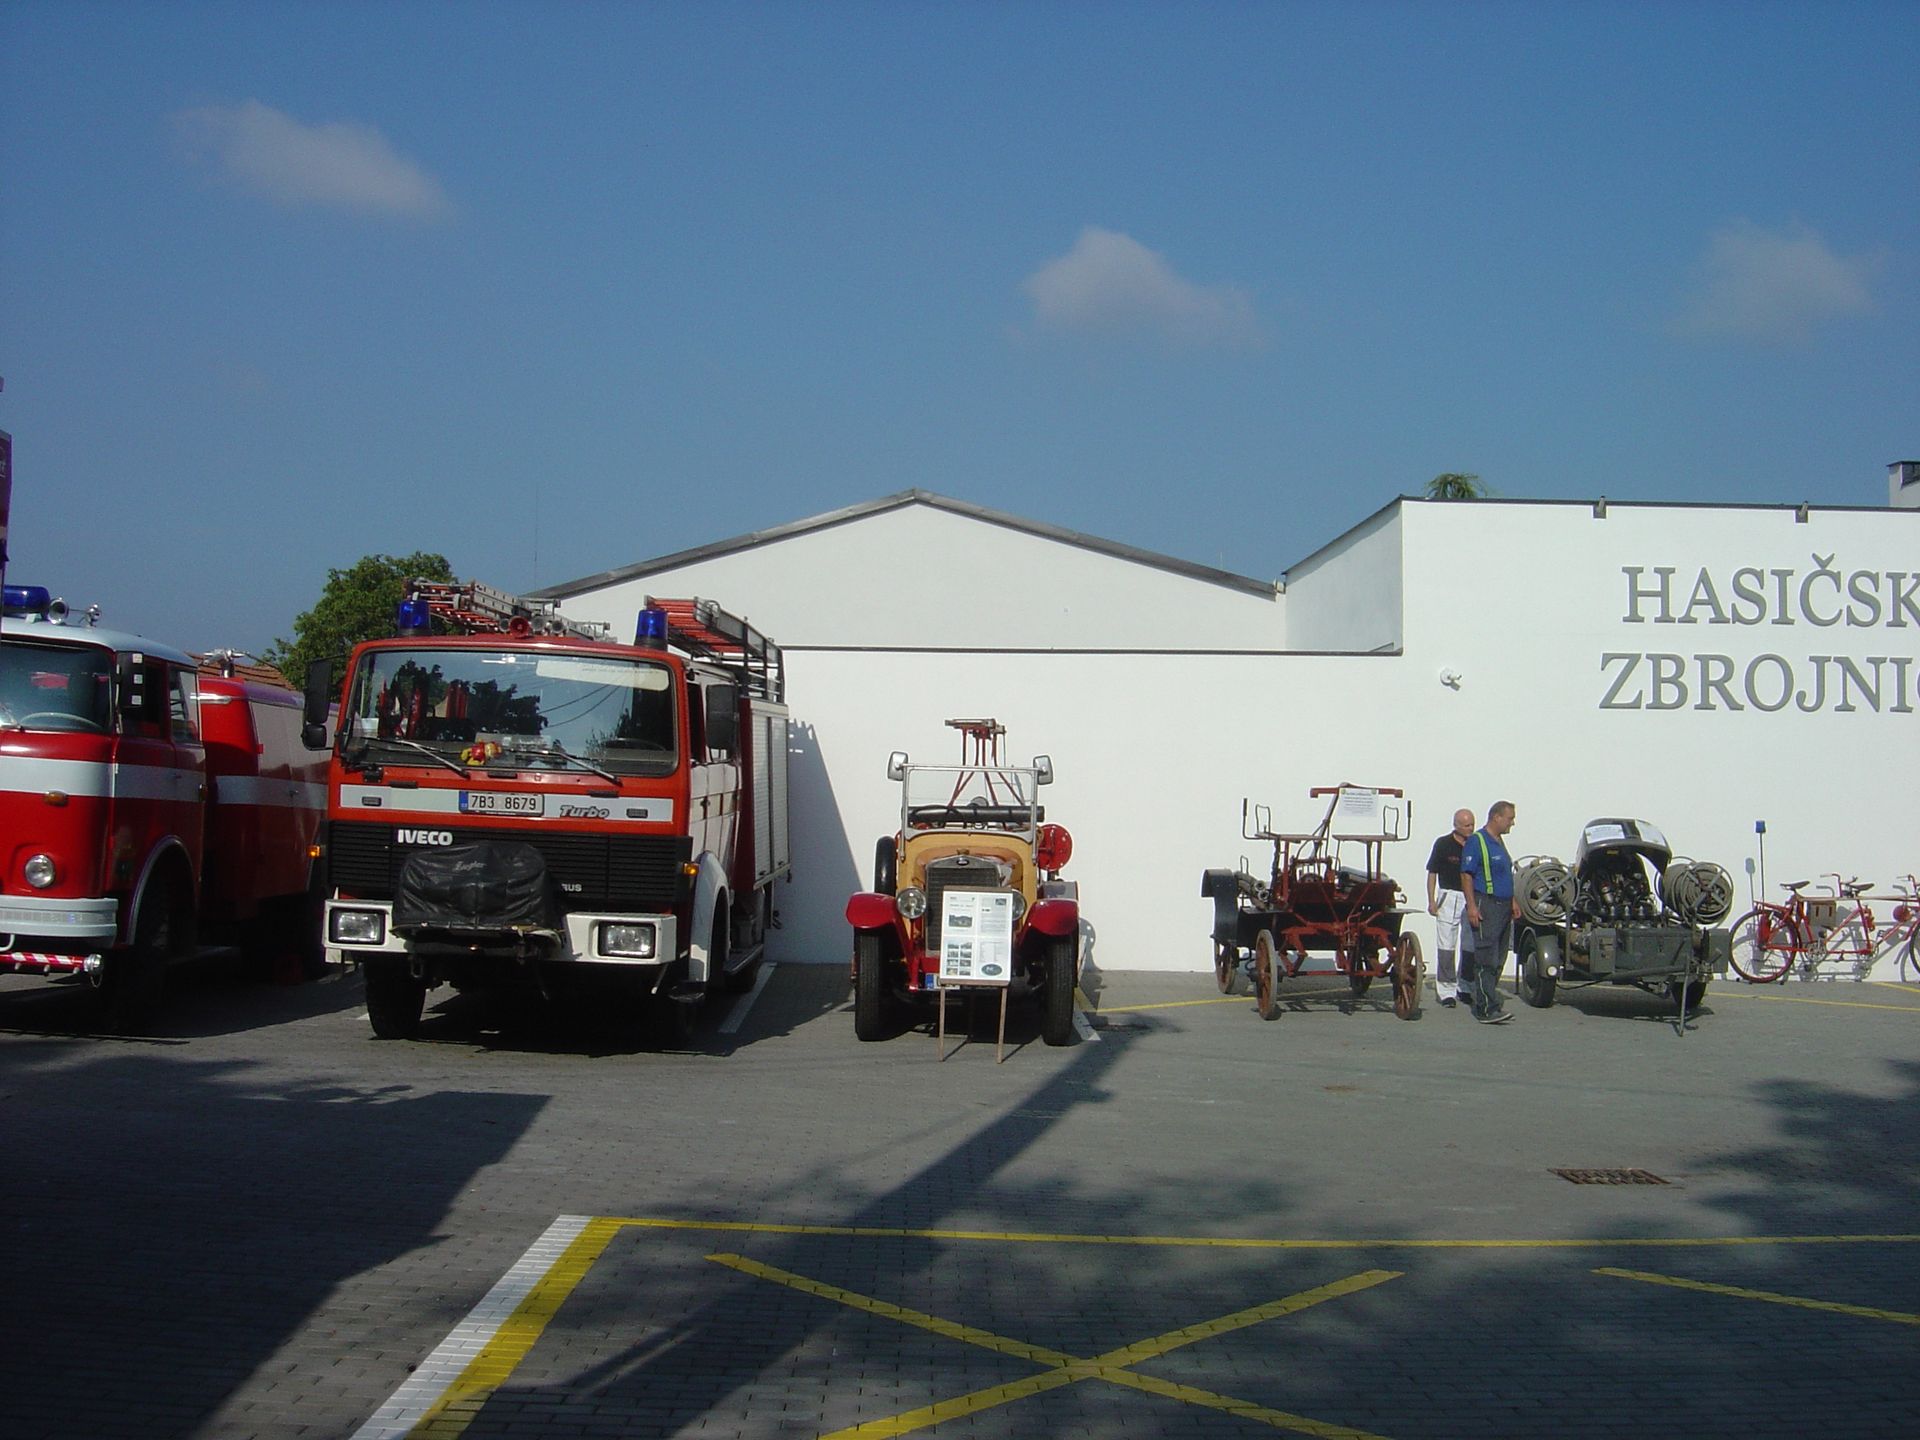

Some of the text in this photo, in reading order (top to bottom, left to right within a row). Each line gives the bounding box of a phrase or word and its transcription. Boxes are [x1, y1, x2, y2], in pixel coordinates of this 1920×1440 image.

[1621, 552, 1920, 628] HASIČSK
[1599, 652, 1920, 713] ZBROJNI
[471, 795, 537, 811] 7B3 8679
[560, 804, 610, 819] Turbo
[397, 829, 453, 846] IVECO
